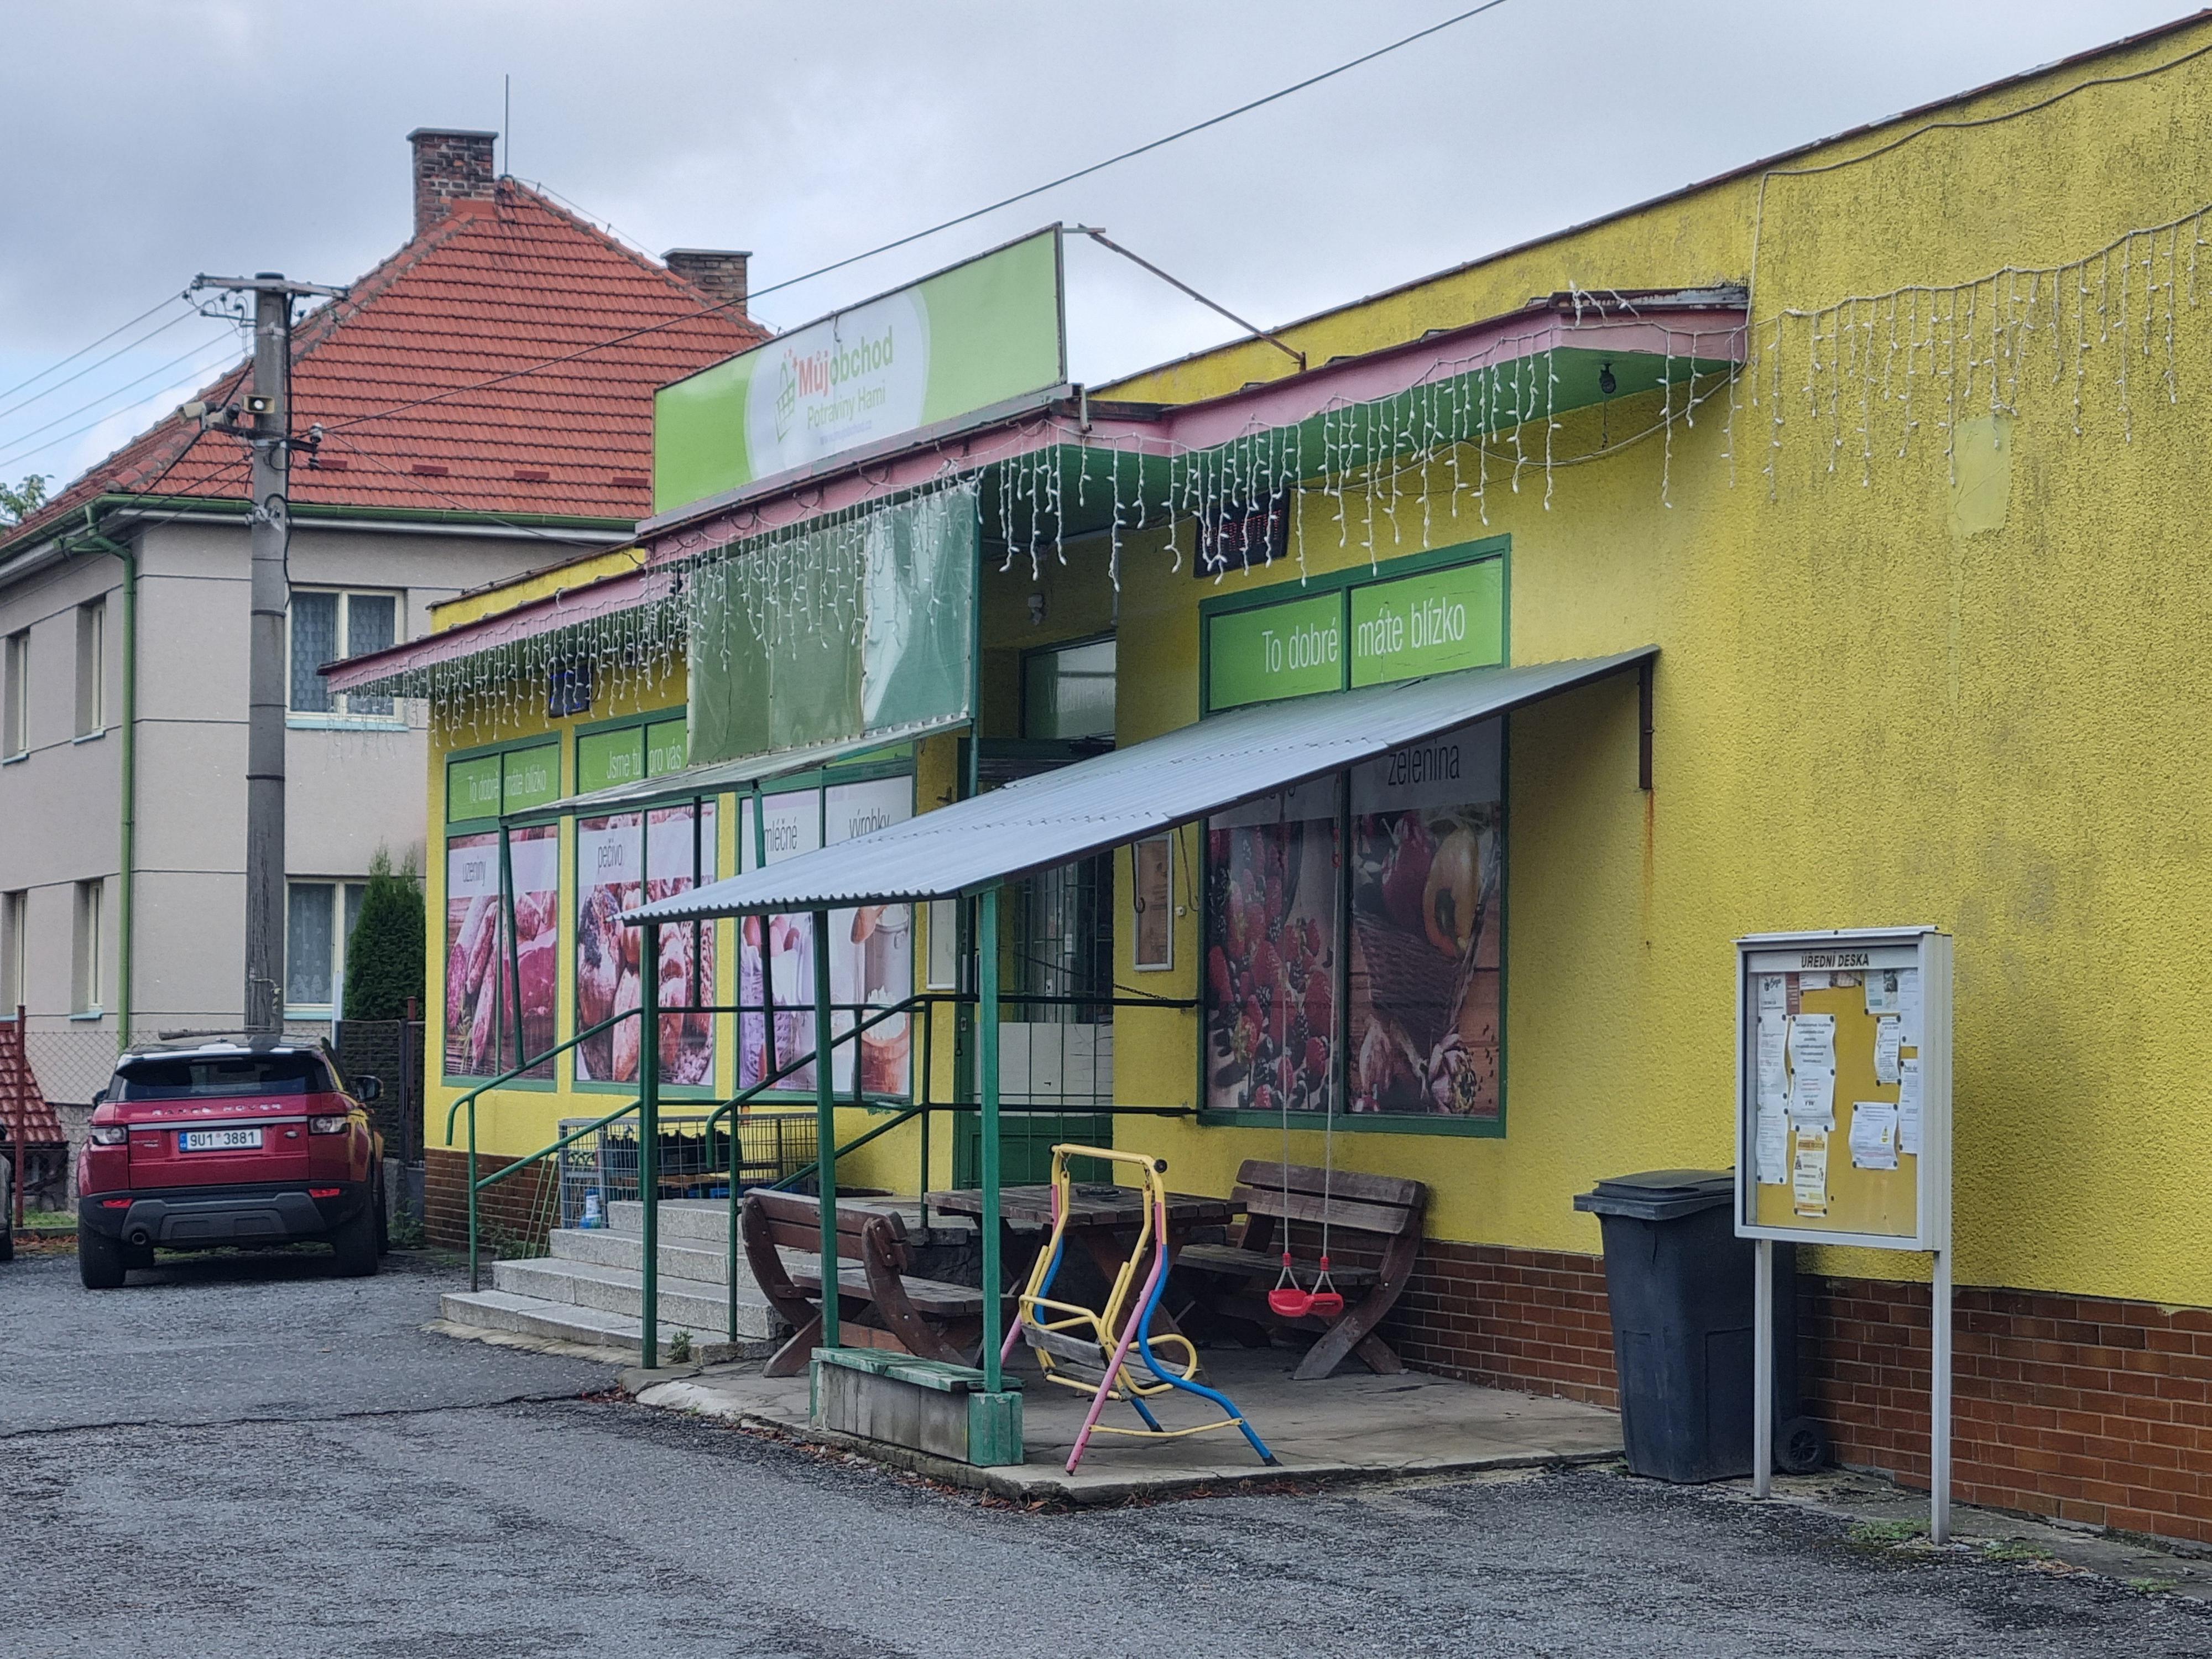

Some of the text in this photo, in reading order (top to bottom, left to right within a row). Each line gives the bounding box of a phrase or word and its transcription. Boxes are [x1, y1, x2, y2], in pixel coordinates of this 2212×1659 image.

[807, 395, 855, 430] Potraviny
[1261, 596, 1465, 673] To dobré máte blízko
[606, 738, 681, 779] Jsme tu pro vás
[1388, 739, 1460, 786] zelenina
[765, 816, 797, 852] mléčné
[462, 856, 487, 886] uzeniny
[598, 838, 623, 875] pečivo
[1838, 953, 1869, 967] DESKA
[190, 1131, 255, 1147] 9U1 3881
